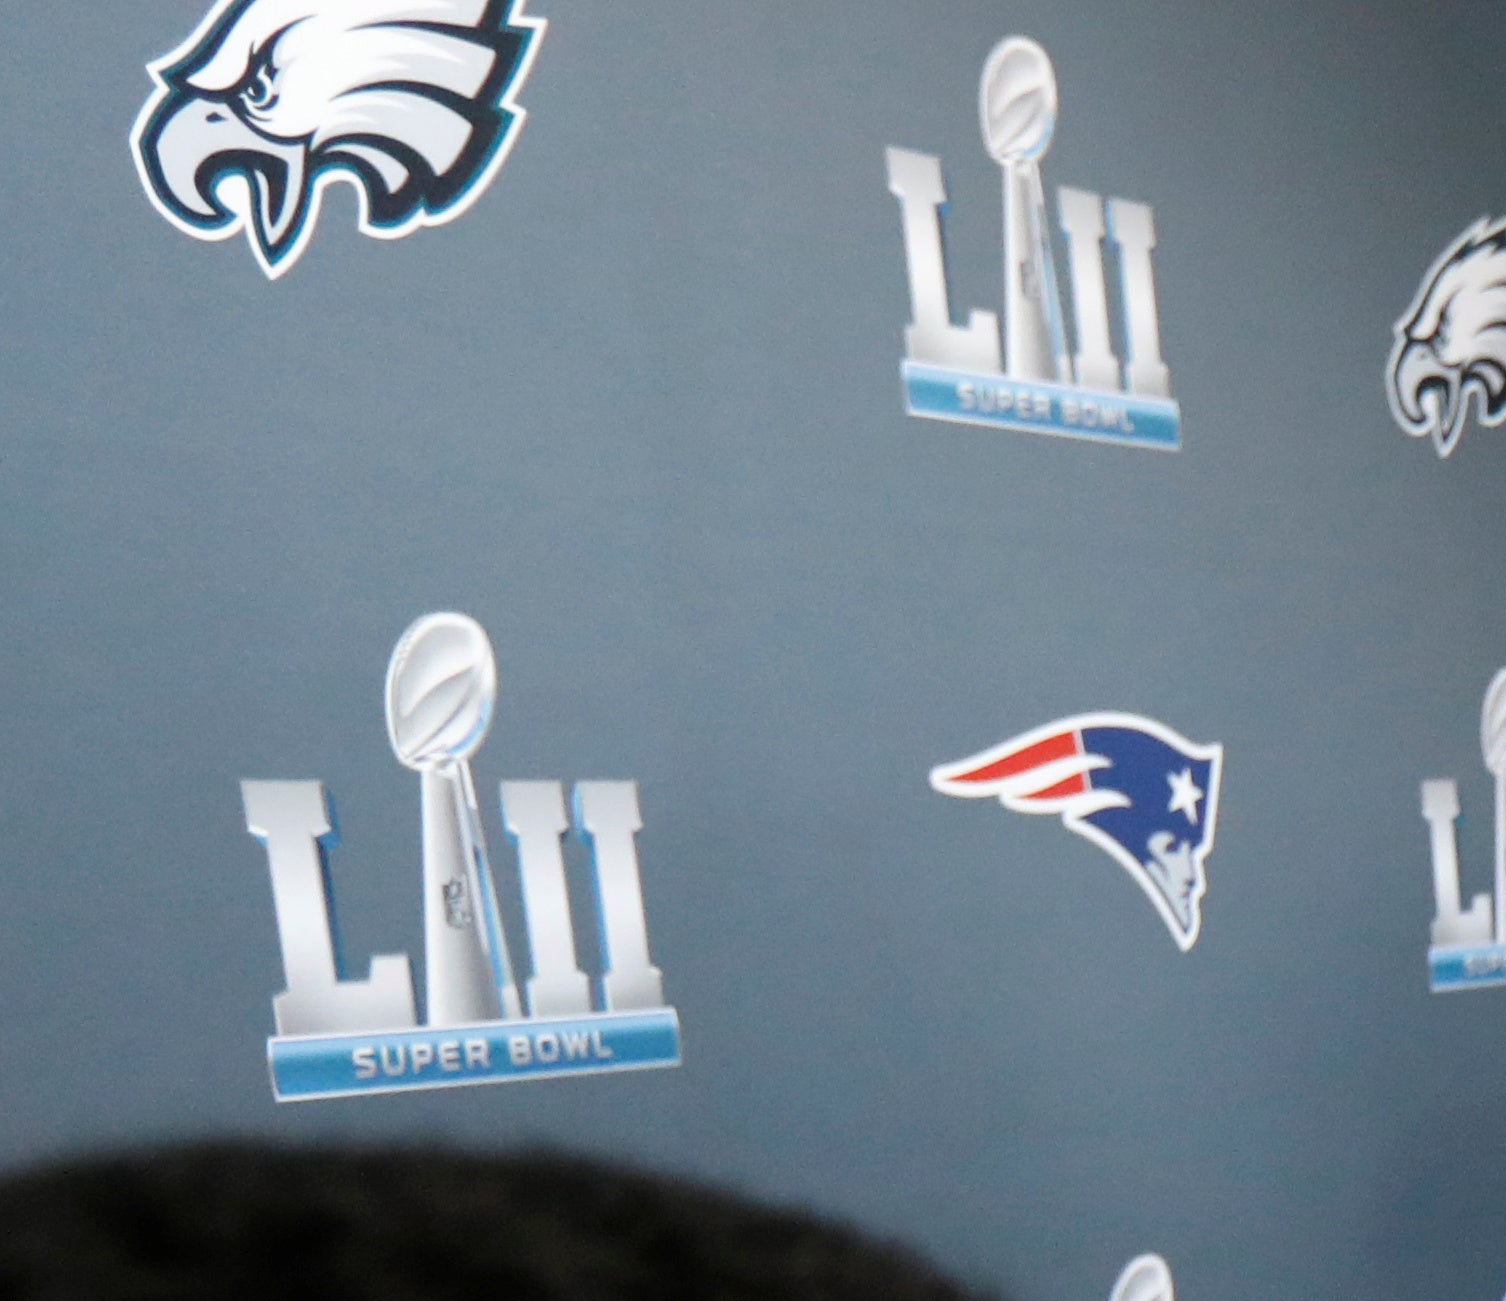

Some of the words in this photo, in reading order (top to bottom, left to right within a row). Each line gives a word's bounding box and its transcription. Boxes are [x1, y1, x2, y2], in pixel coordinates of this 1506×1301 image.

[956, 379, 1050, 420] SUPER
[1062, 399, 1135, 433] BOWL
[352, 1037, 490, 1079] SUPER
[510, 1029, 614, 1066] BOWL
